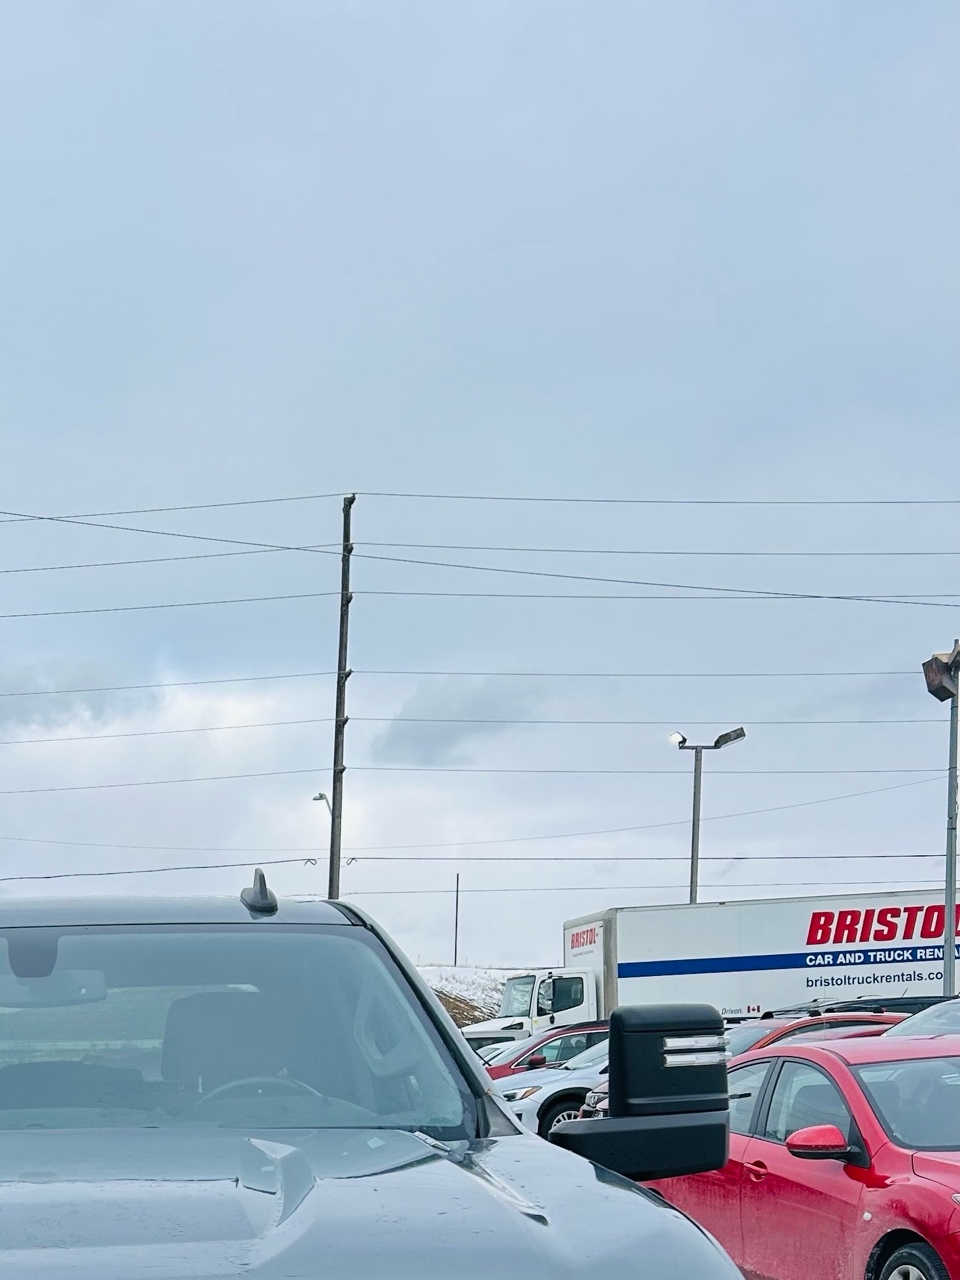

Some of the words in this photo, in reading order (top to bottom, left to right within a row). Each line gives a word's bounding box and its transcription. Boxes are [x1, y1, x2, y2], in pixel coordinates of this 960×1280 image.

[571, 928, 596, 949] BRISTOL
[806, 954, 833, 966] CAR
[837, 952, 865, 964] AND
[868, 949, 913, 962] TRUCK
[806, 970, 944, 988] bristoltruckrentals.co
